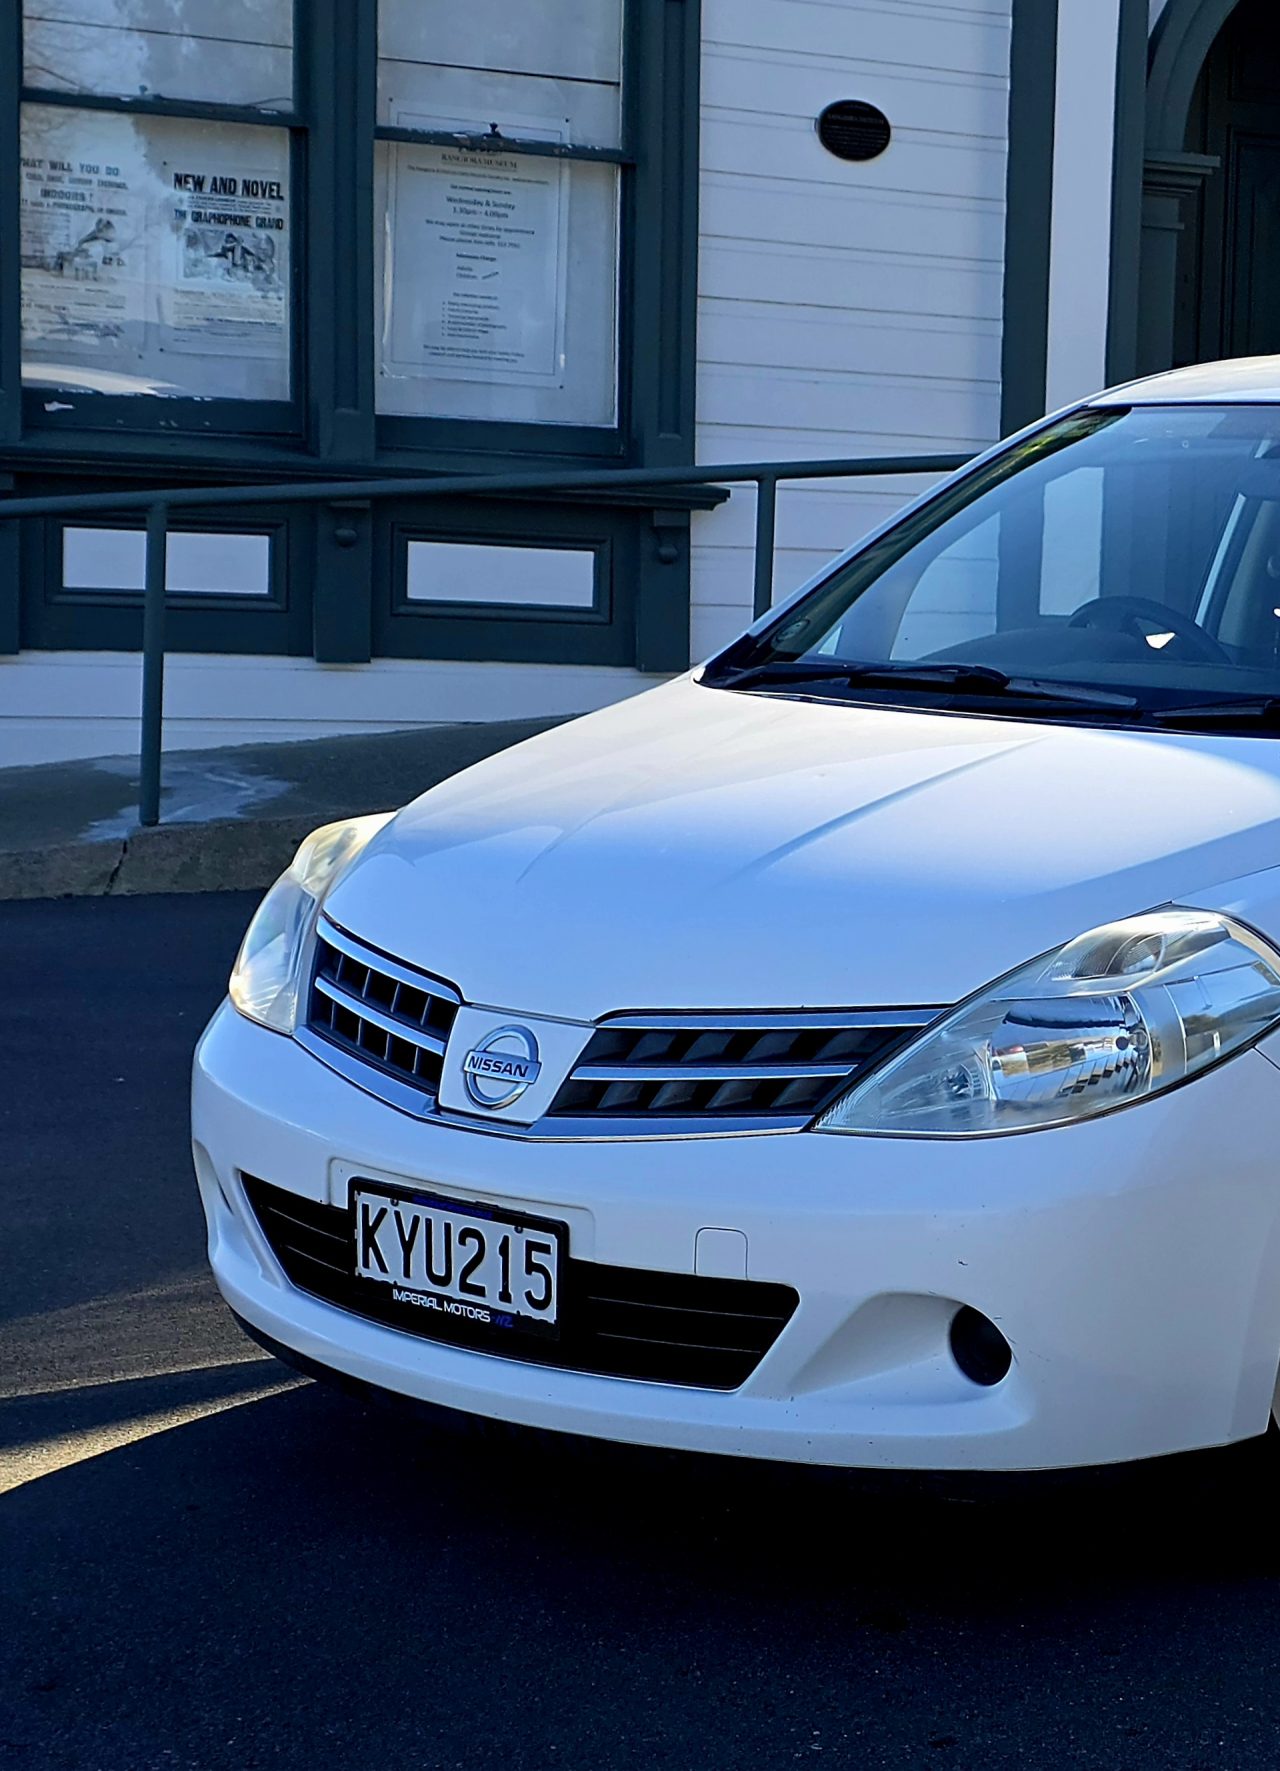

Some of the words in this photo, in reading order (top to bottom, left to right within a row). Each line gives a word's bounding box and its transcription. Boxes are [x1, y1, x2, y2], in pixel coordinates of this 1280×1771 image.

[21, 158, 43, 169] HAT
[79, 163, 99, 174] YOU
[173, 172, 205, 192] NEW
[209, 176, 237, 196] AND
[241, 179, 285, 201] NOVEL
[191, 210, 252, 228] GRAPHOPHONE
[468, 1055, 528, 1078] NISSAN
[361, 1203, 552, 1311] KYU215
[393, 1288, 442, 1311] IMPERIAL
[444, 1300, 491, 1323] MOTORS
